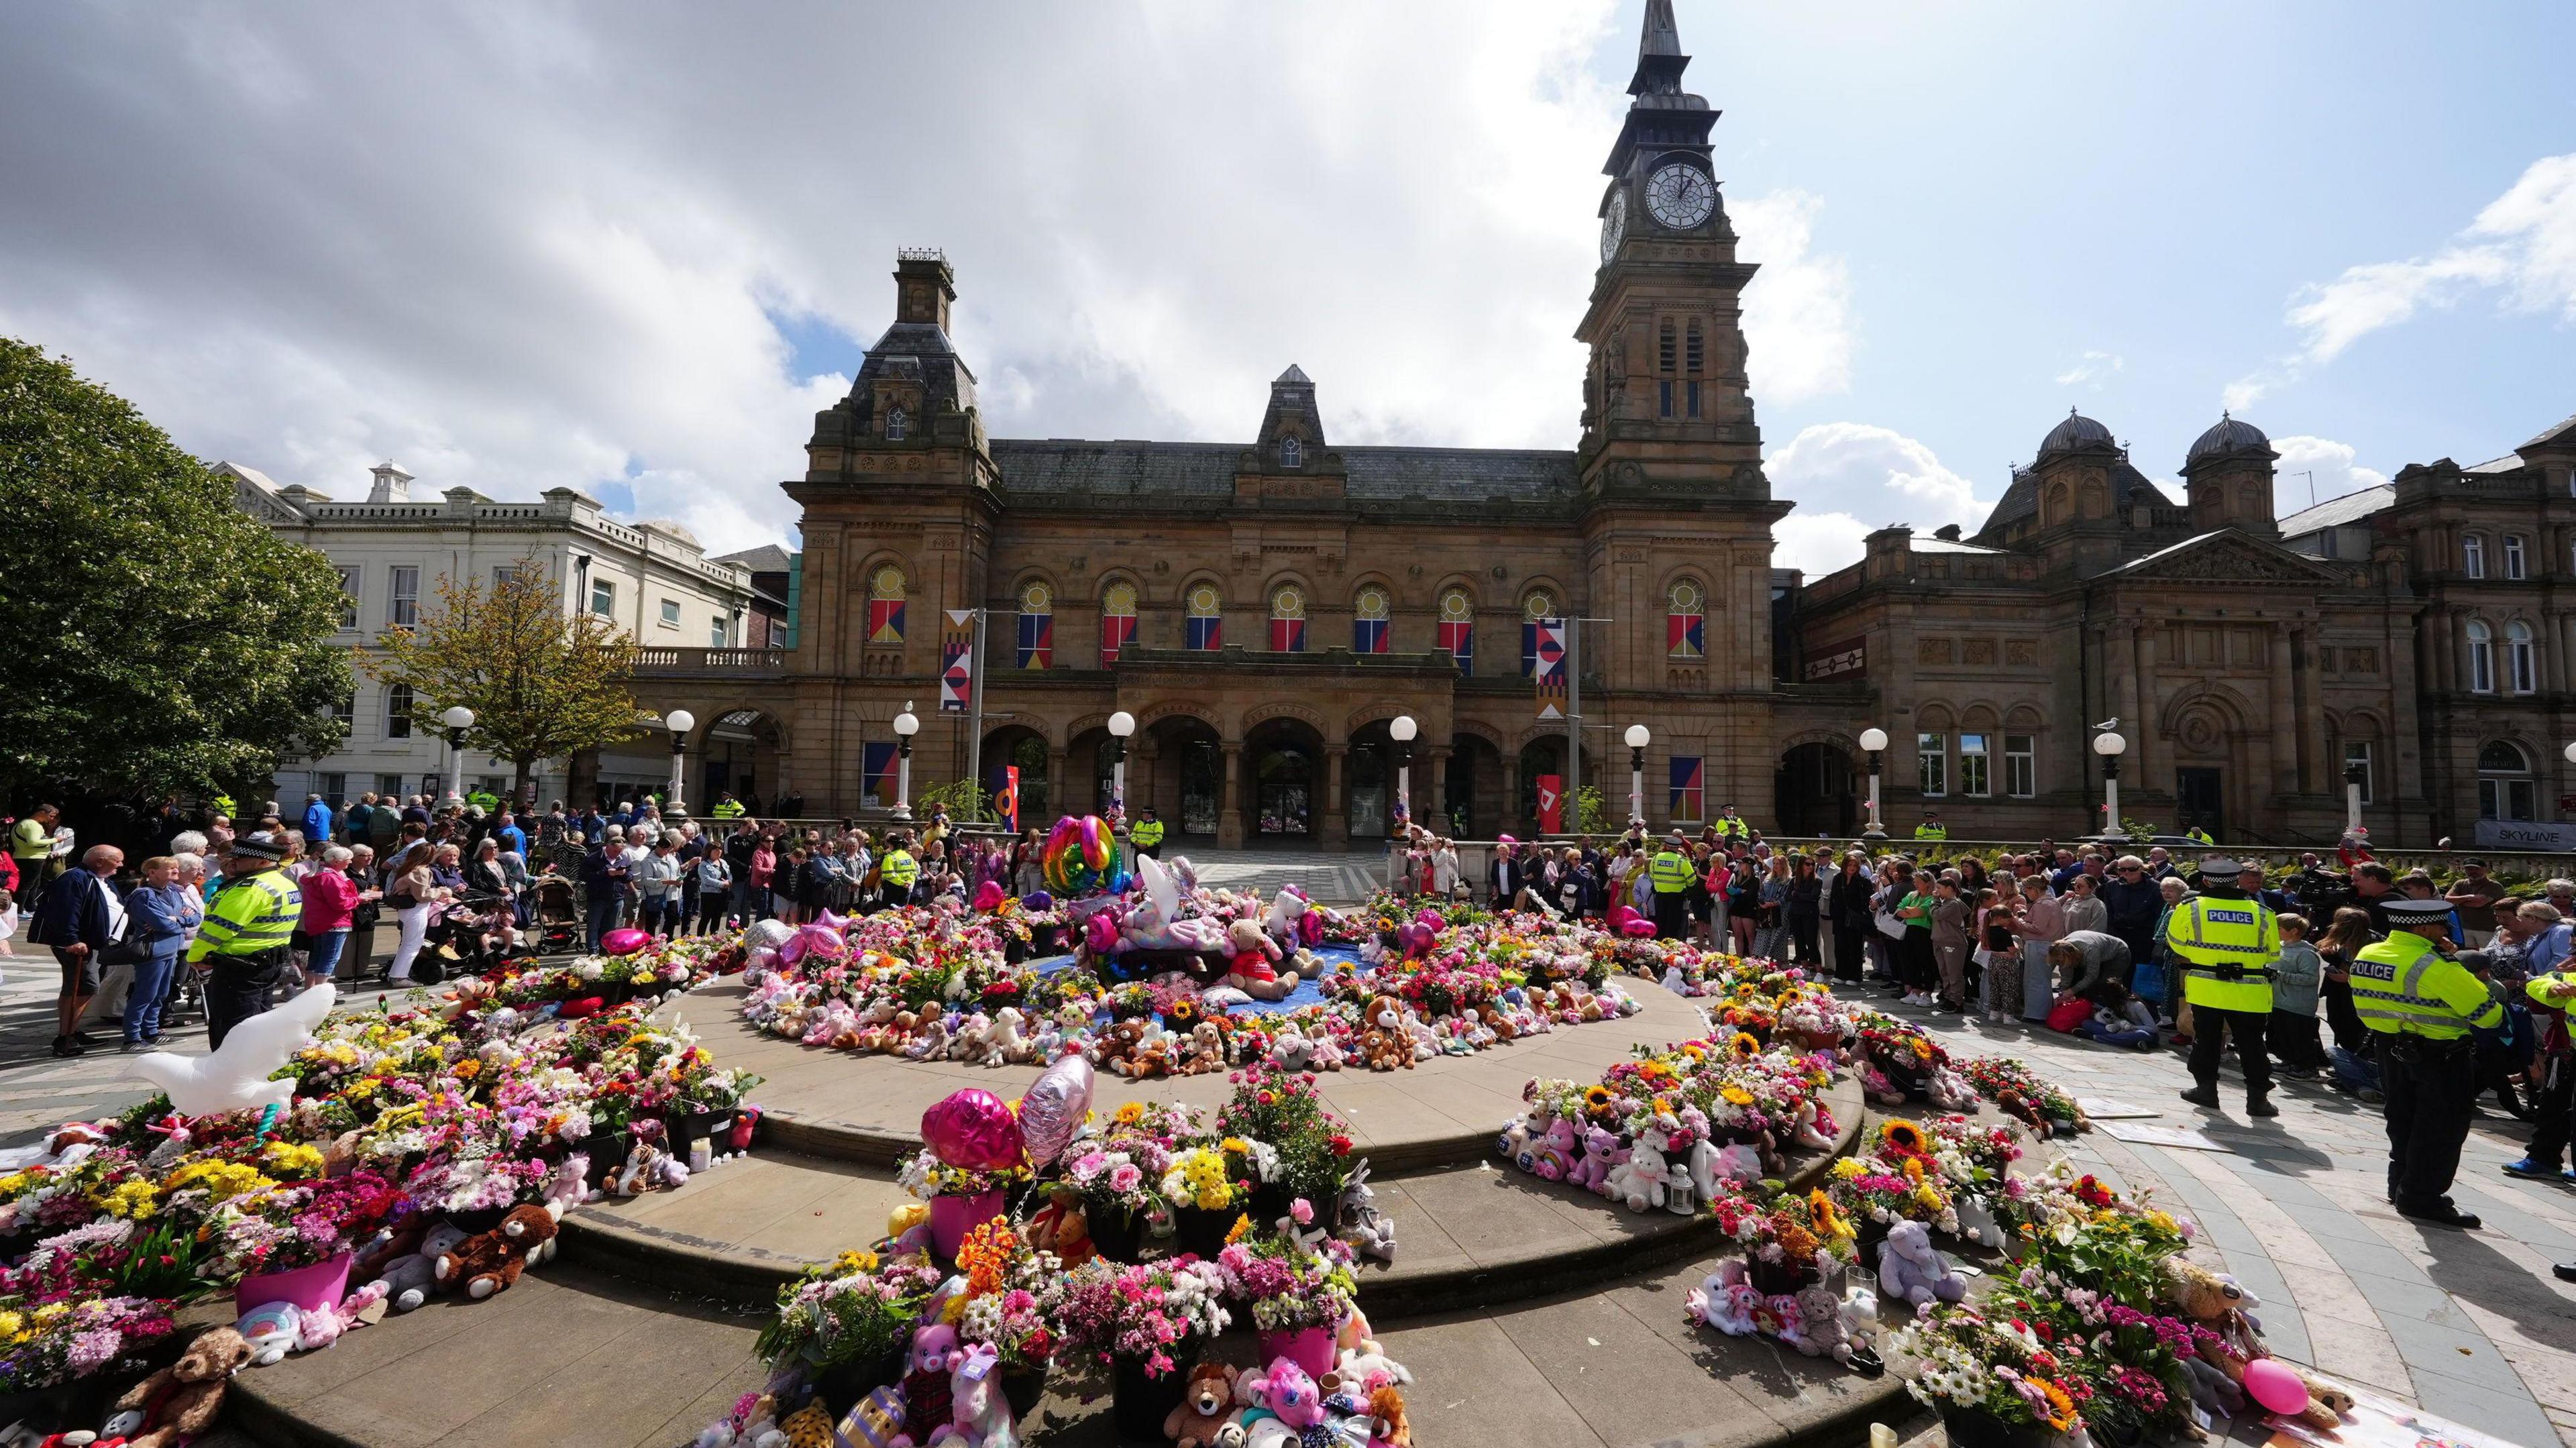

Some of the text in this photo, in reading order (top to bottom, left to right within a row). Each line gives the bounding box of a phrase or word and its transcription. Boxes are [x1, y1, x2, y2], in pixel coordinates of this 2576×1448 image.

[2500, 830, 2559, 842] SKYLINE
[2208, 911, 2252, 923] POLICE
[2351, 962, 2393, 979] POLICE
